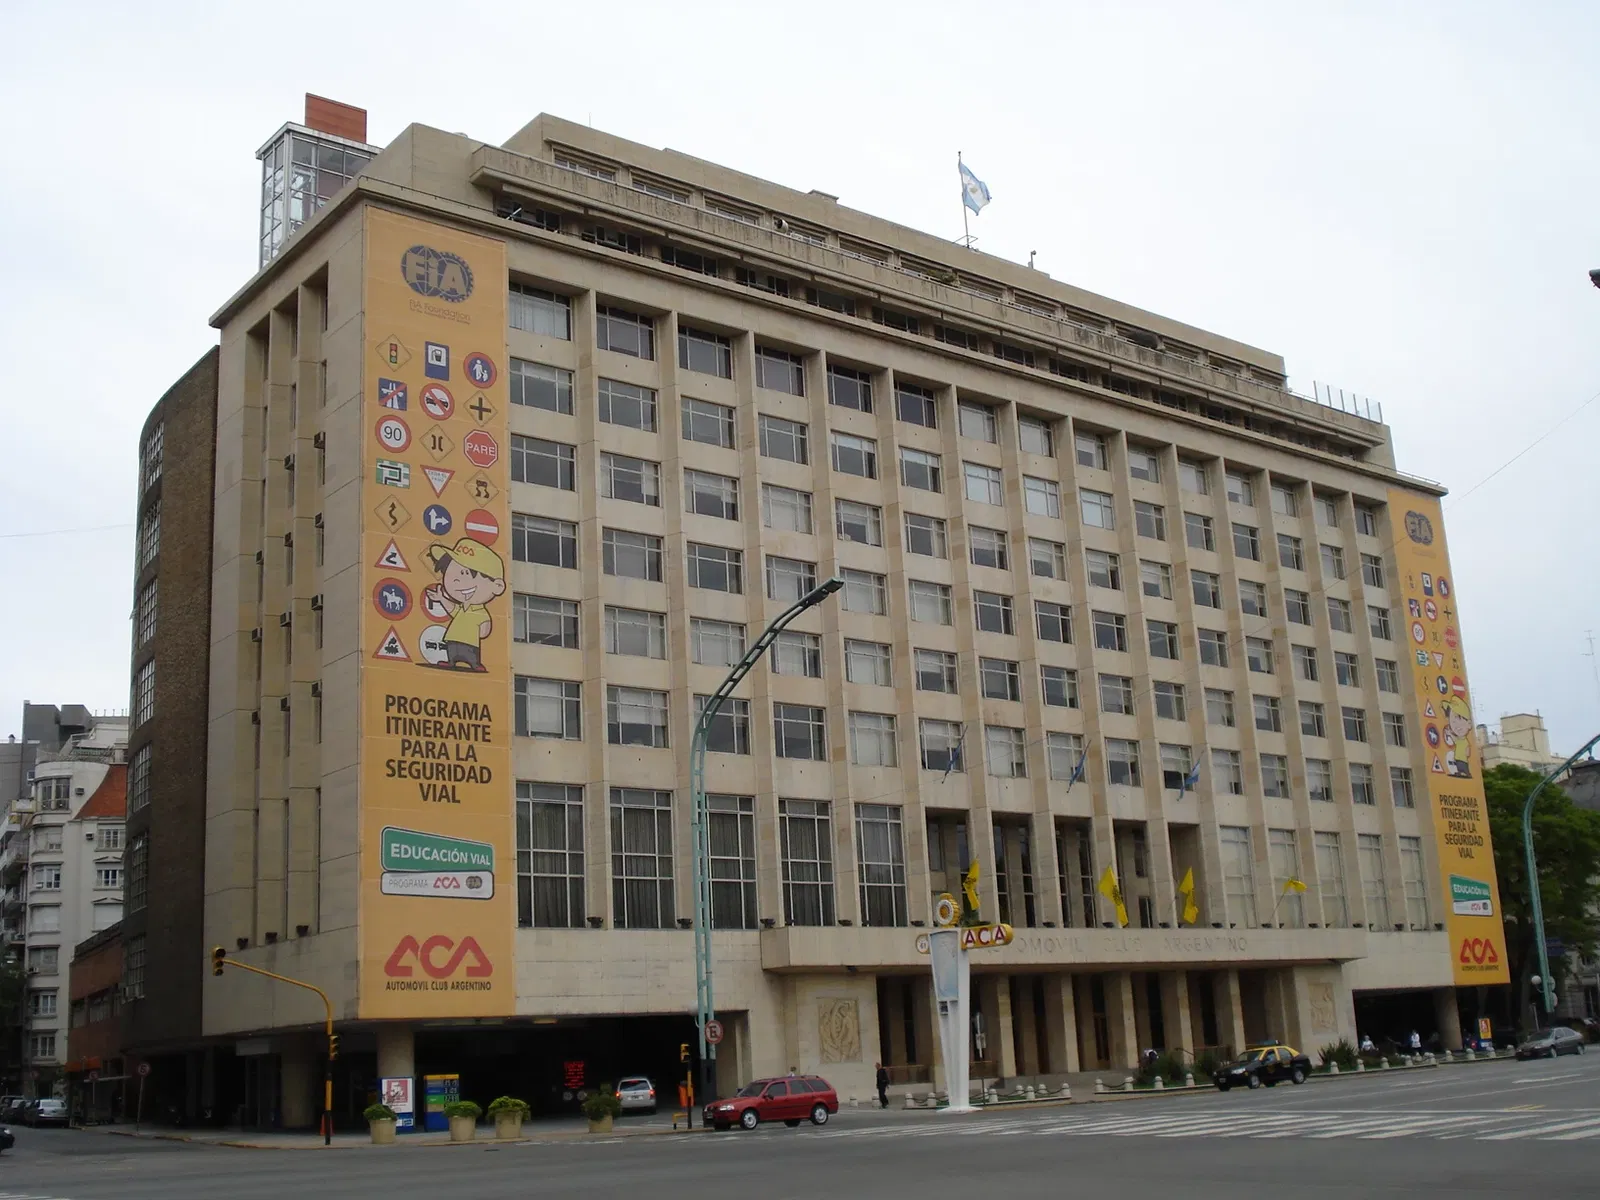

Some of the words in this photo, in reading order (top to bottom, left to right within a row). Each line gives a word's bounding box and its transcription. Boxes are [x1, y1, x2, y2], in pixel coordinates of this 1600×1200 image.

[384, 425, 402, 441] 90
[466, 443, 496, 456] PARE
[385, 694, 492, 722] PROGRAMA
[386, 716, 492, 743] ITINERANTE
[401, 738, 450, 760] PARA
[455, 743, 478, 763] LA
[385, 758, 492, 784] SEGURIDAD
[419, 782, 461, 804] VIAL
[1439, 794, 1479, 808] PROGRAMA
[1441, 807, 1480, 821] ITINERANTE
[1448, 820, 1467, 833] PARA
[1467, 821, 1477, 833] LA
[1444, 832, 1484, 847] SEGURIDAD
[390, 843, 468, 863] EDUCACIÓN
[470, 852, 491, 866] VIAL
[1458, 846, 1475, 859] VIAL
[388, 879, 429, 889] PROGRAMA
[433, 876, 461, 889] ACA
[964, 925, 1006, 945] ACA
[384, 935, 493, 979] ACA
[1460, 938, 1498, 964] ACA
[430, 981, 449, 991] CLUB
[450, 981, 492, 991] ARGENTINO
